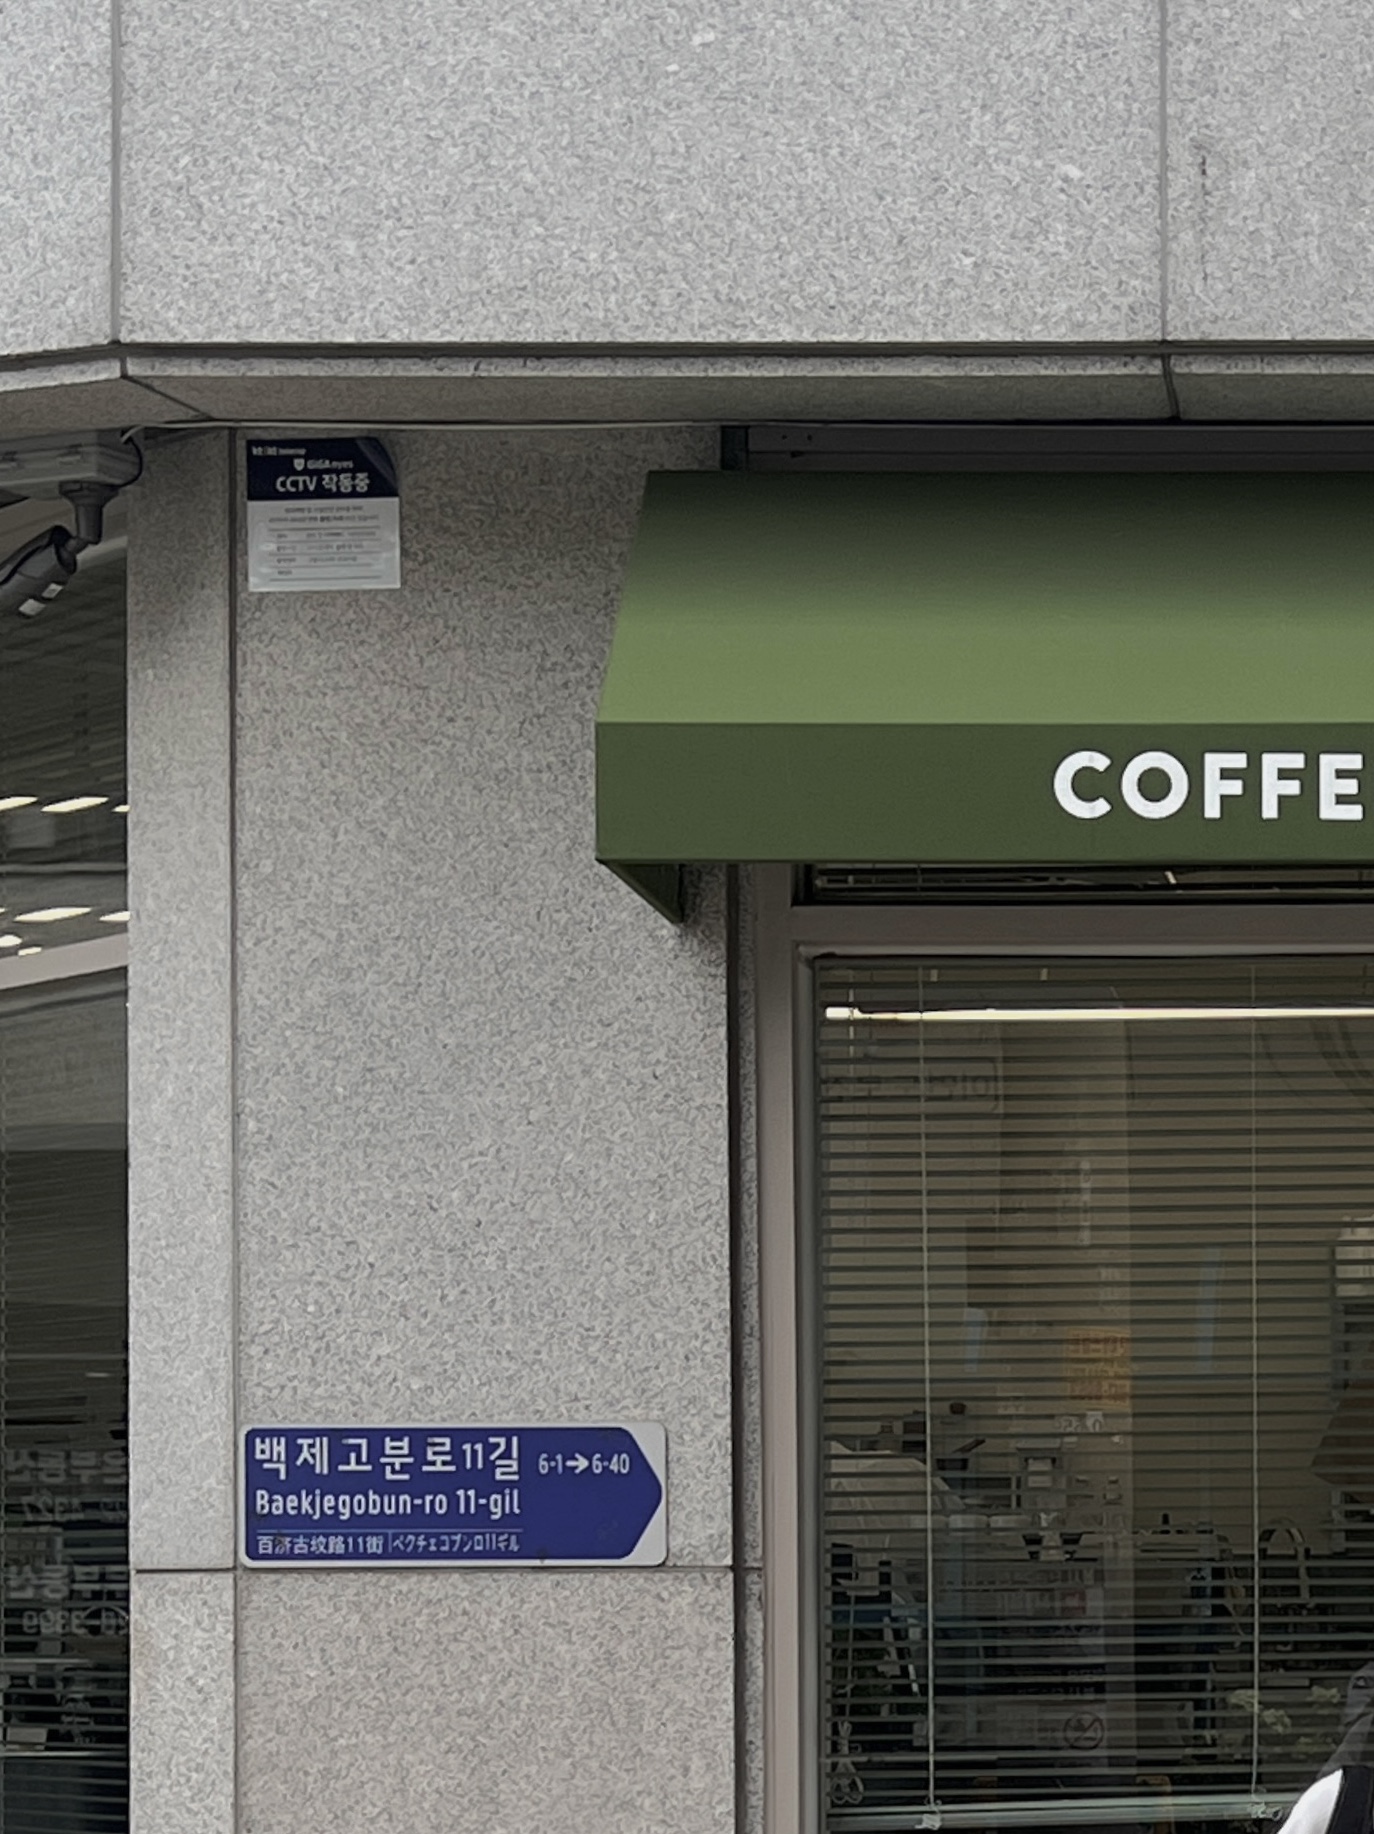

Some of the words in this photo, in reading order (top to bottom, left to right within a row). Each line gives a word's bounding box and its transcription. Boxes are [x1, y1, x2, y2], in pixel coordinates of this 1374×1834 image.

[275, 476, 317, 492] CCTV
[321, 472, 370, 493] 작동중
[255, 1488, 448, 1520] Baekjegobun-ro
[456, 1488, 521, 1520] 11-gil
